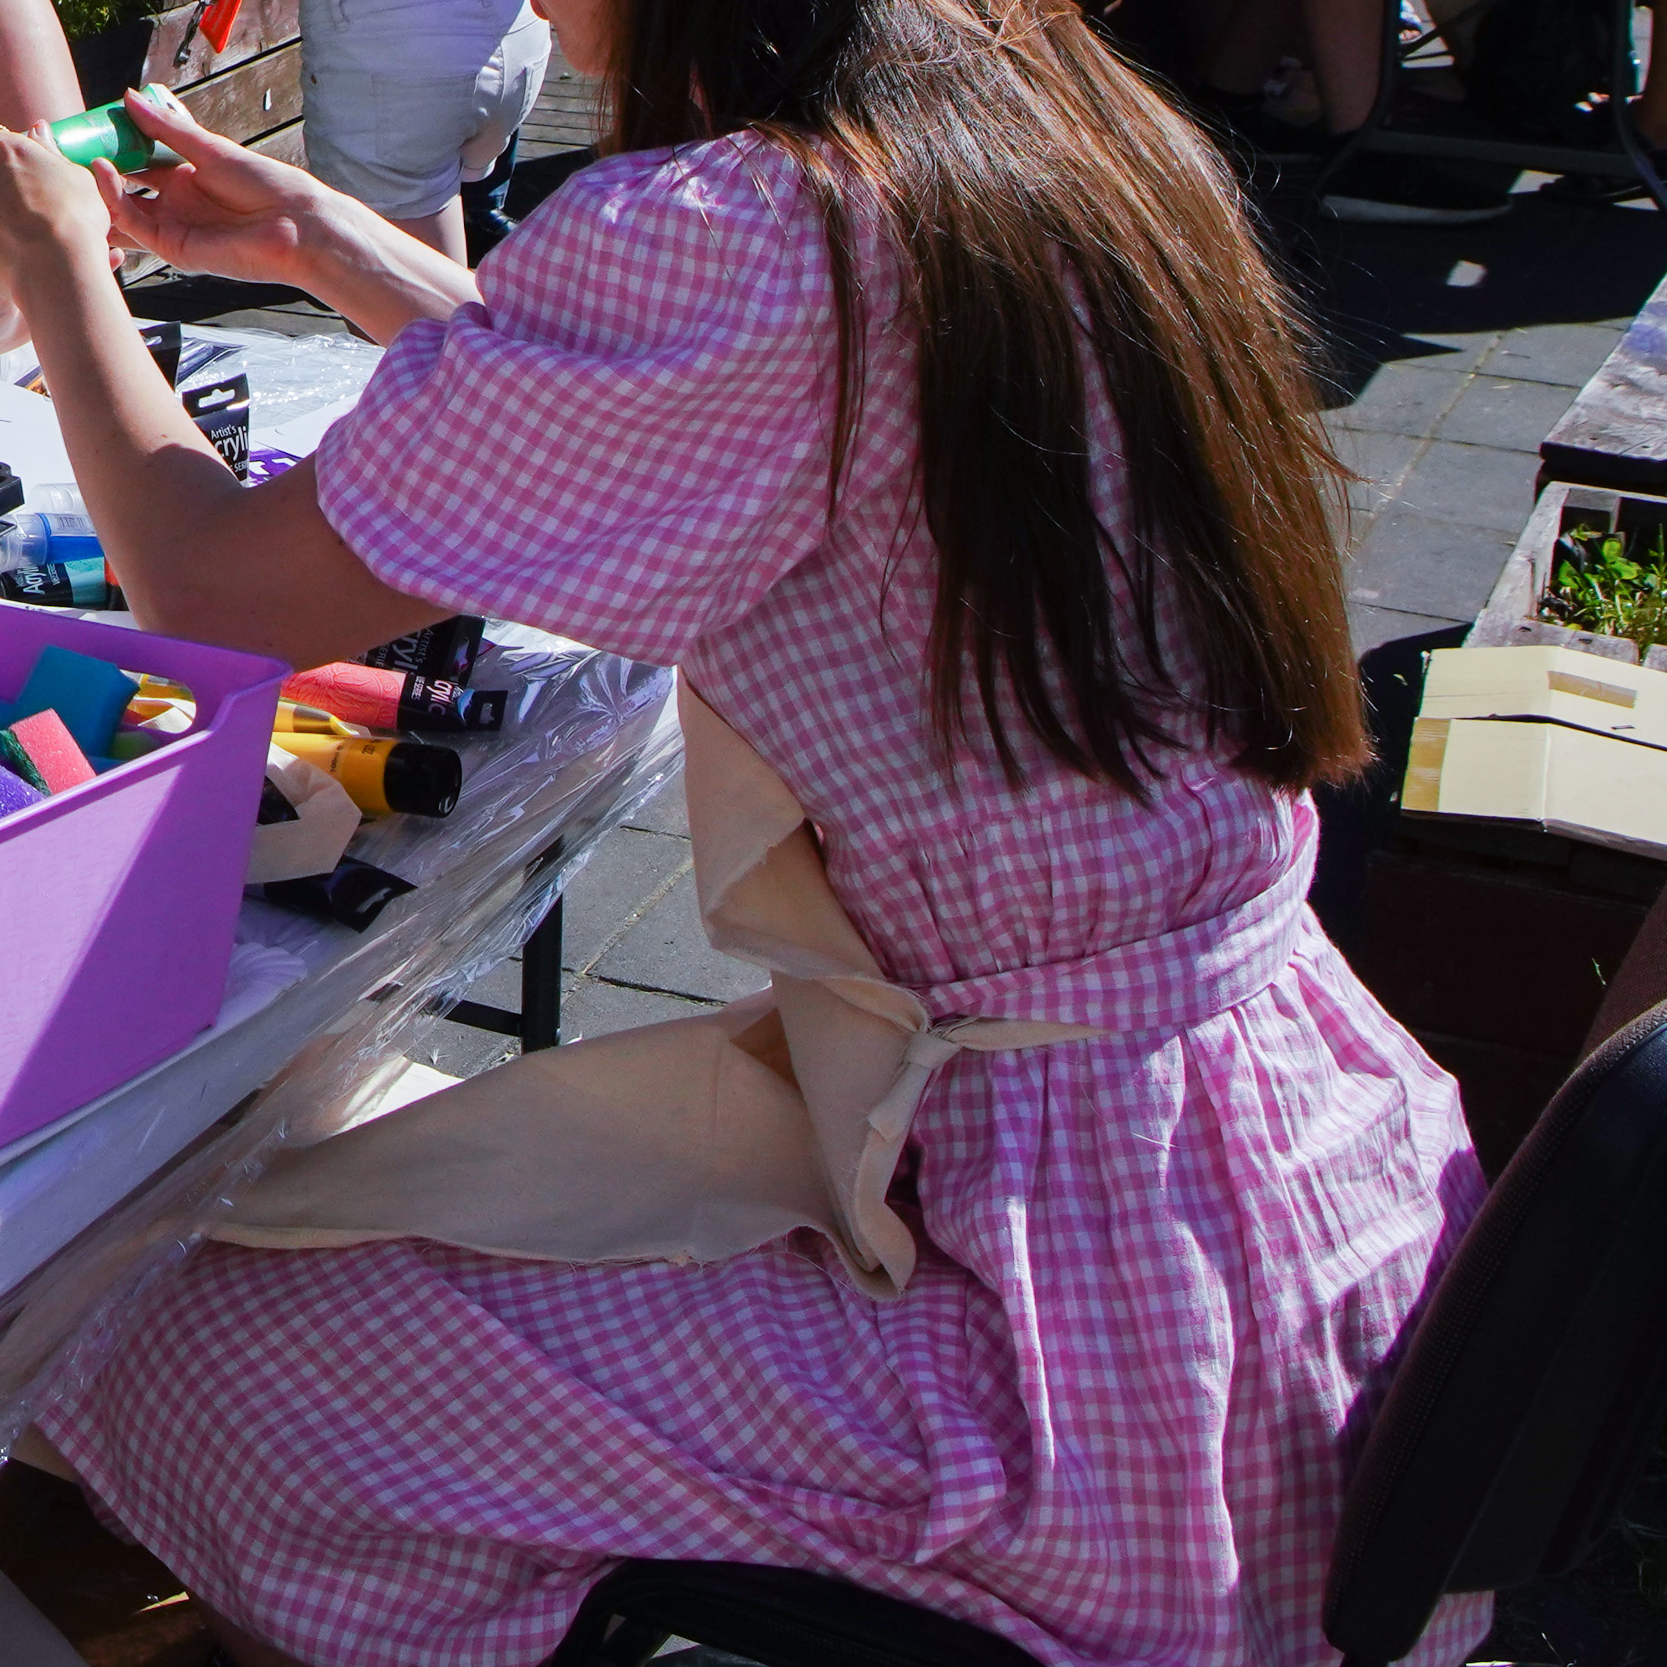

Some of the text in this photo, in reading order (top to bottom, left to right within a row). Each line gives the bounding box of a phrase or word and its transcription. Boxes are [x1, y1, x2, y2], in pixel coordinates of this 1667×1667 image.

[210, 424, 237, 440] Artist's
[214, 426, 249, 462] cryli
[415, 627, 435, 664] Artist's
